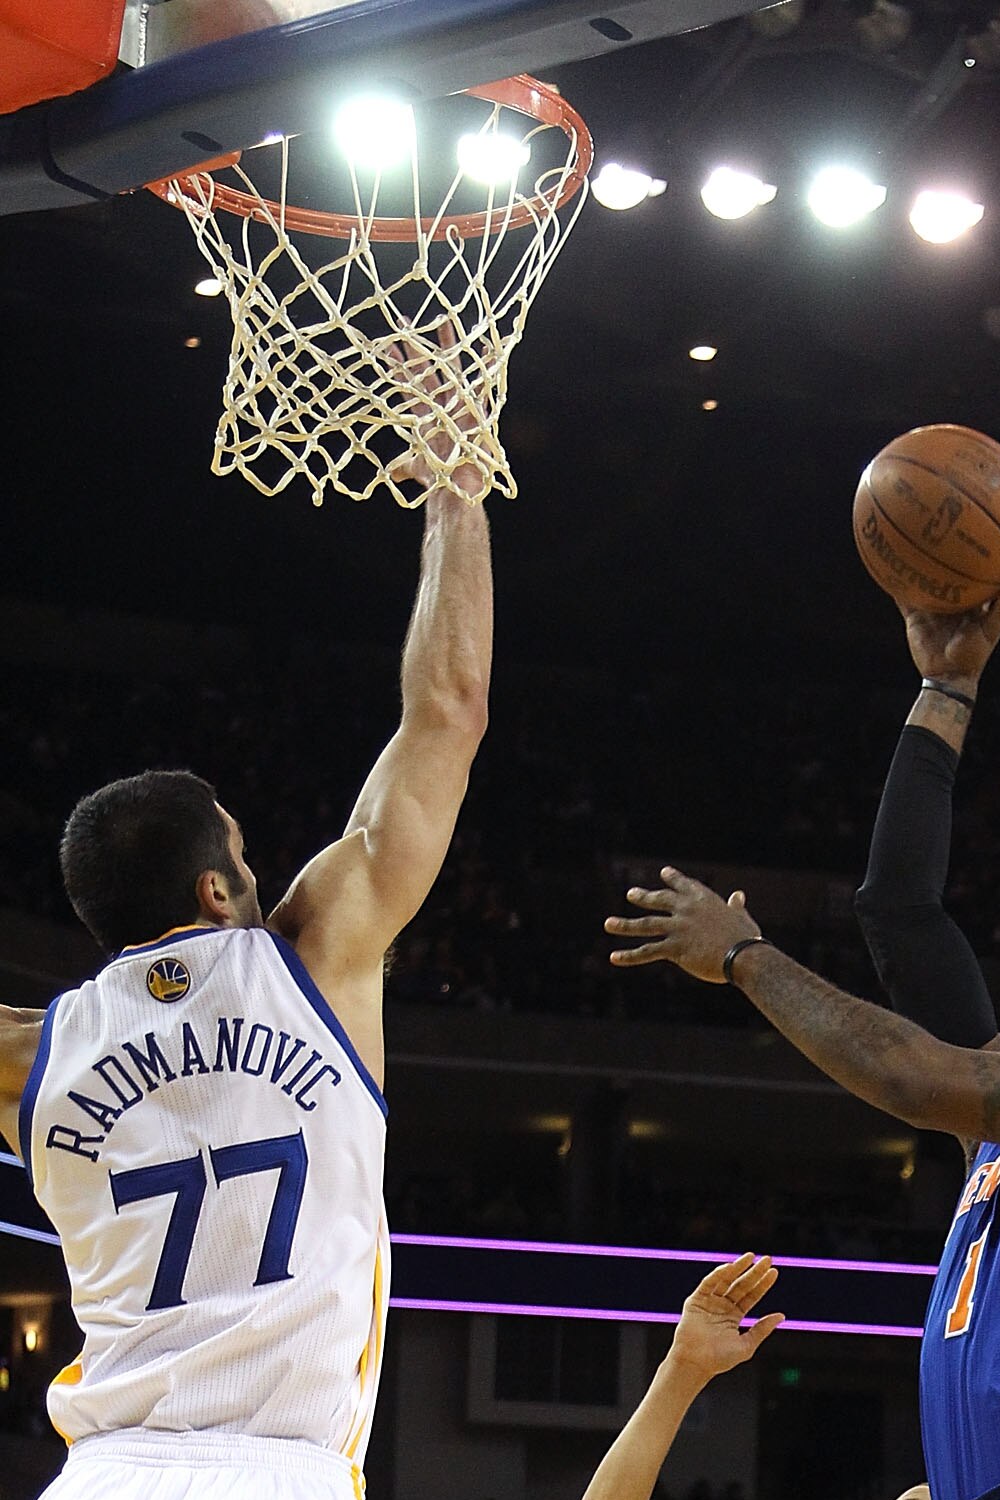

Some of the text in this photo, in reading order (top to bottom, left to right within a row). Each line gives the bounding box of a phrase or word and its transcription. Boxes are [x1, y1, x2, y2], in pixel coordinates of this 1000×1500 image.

[45, 1017, 341, 1163] RADMANOVIC
[109, 1127, 309, 1312] 77
[945, 1222, 991, 1339] 1
